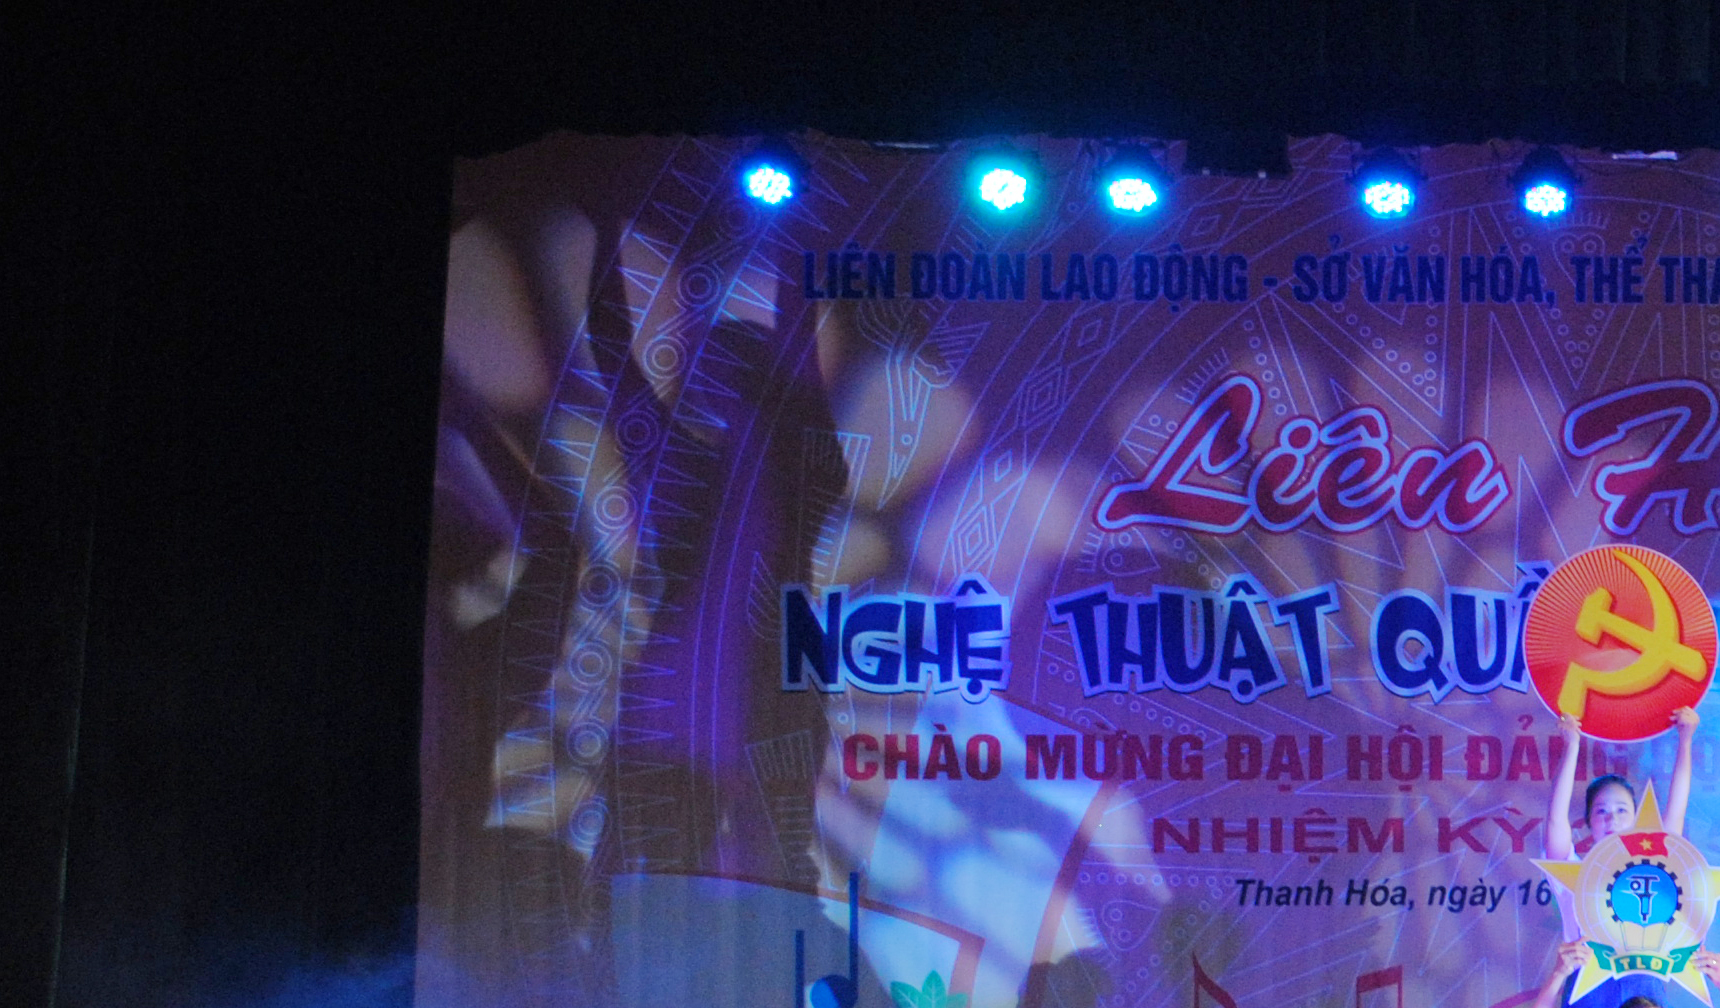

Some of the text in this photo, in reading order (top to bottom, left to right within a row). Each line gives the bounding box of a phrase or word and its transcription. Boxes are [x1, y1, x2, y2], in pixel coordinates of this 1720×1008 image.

[803, 241, 897, 299] LIÊN
[909, 240, 1025, 300] ĐOÀN
[1038, 252, 1120, 301] LAO
[1132, 241, 1250, 313] ĐỘNG
[1264, 278, 1280, 288] -
[1292, 234, 1356, 301] SỞ
[1361, 242, 1444, 302] VĂN
[1459, 241, 1557, 308] HÓA,
[1569, 234, 1648, 304] THỂ
[1096, 372, 1511, 535] Liên
[781, 572, 1012, 703] NGHỆ
[1047, 572, 1340, 704] THUẬT
[843, 724, 1001, 782] CHÀO
[1025, 722, 1204, 782] MỪNG
[1226, 735, 1324, 792] ĐẠI
[1347, 724, 1444, 792] HỘI
[1153, 808, 1405, 864] NHIỆM
[1437, 807, 1544, 853] KỲ
[1235, 878, 1334, 906] Thanh
[1346, 878, 1415, 911] Hóa,
[1428, 877, 1507, 913] ngày
[1518, 878, 1551, 907] 16
